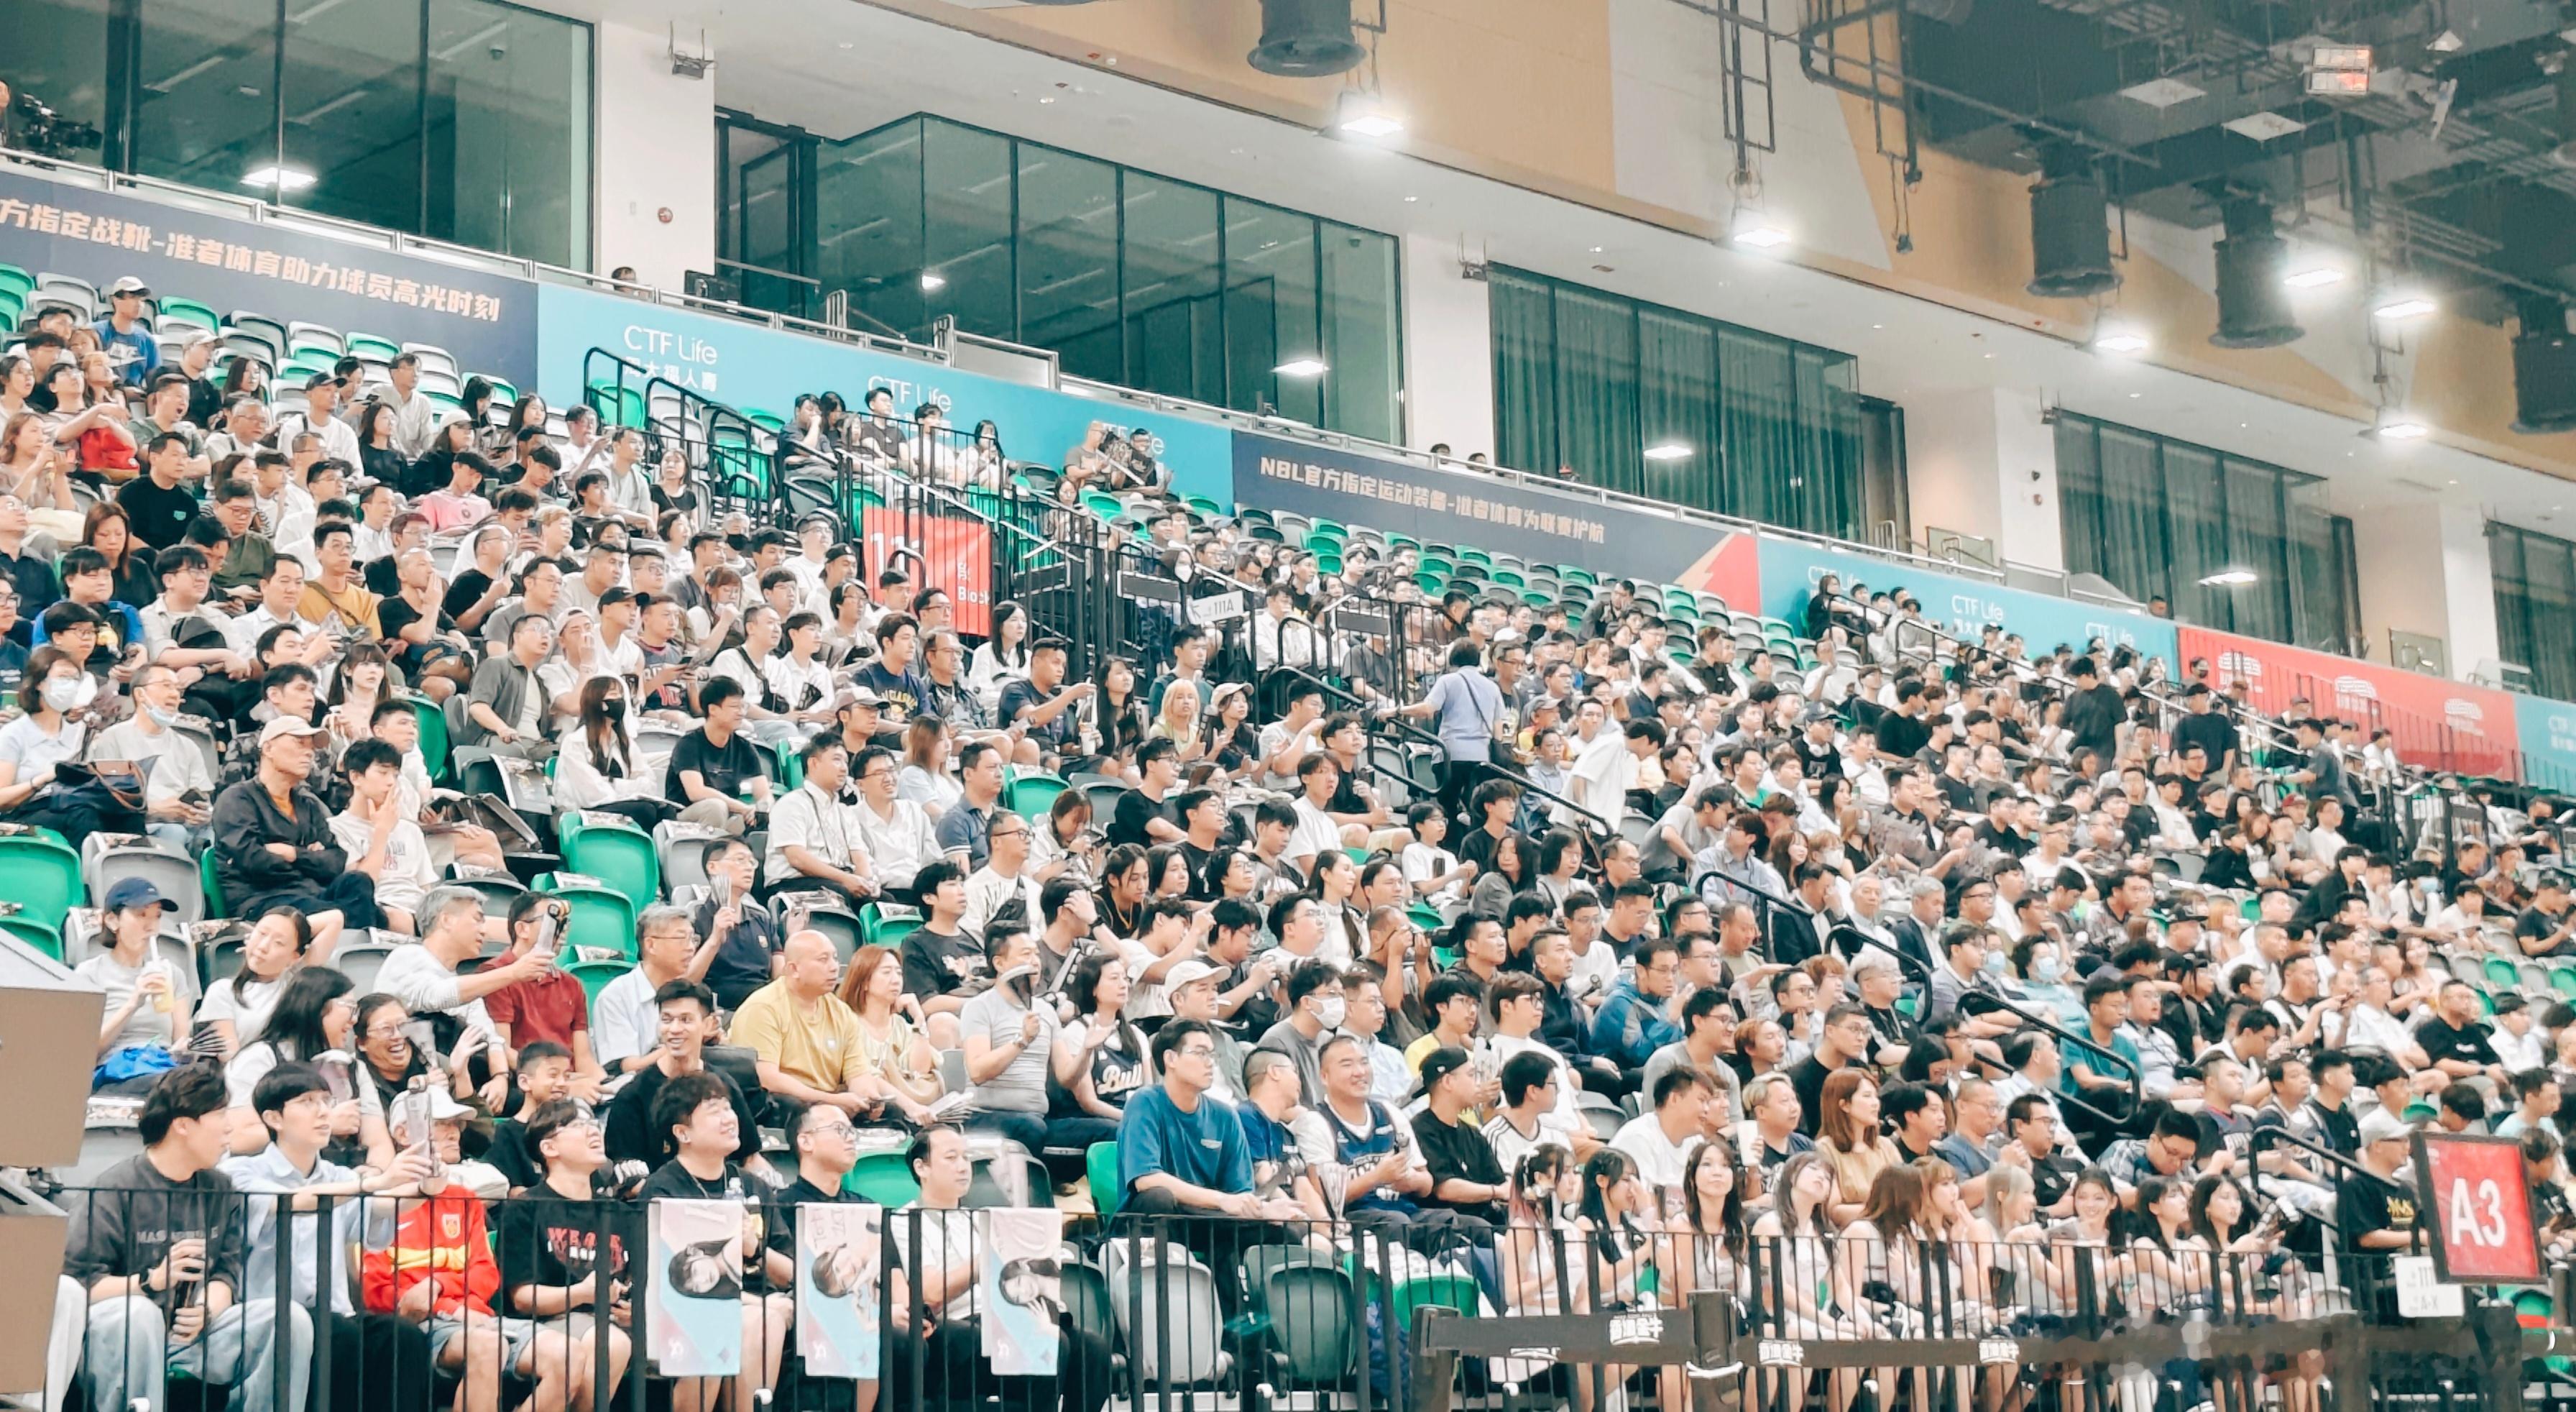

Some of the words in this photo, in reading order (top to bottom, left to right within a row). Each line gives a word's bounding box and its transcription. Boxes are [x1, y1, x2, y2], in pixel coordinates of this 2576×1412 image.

[624, 325, 673, 356] CTF
[678, 334, 718, 365] Life
[1952, 595, 1979, 616] CTF
[2451, 1178, 2507, 1247] A3
